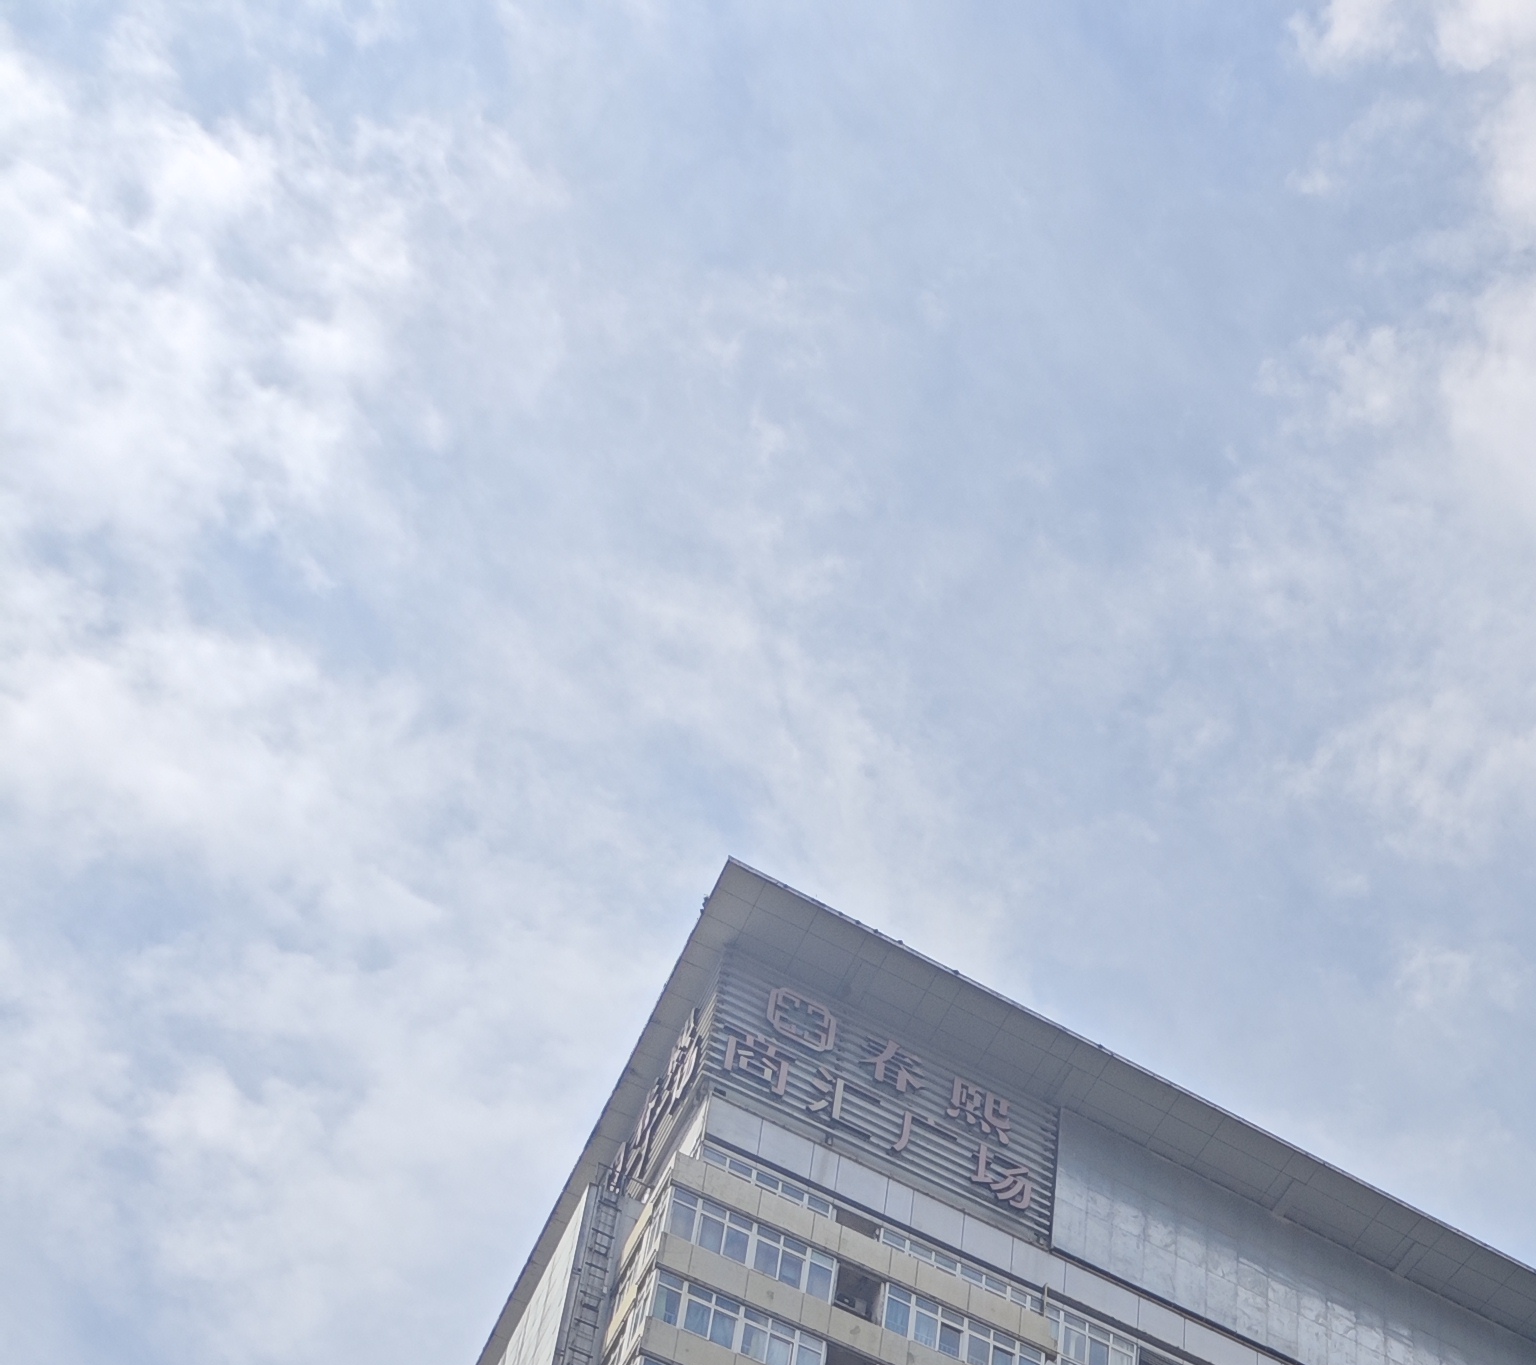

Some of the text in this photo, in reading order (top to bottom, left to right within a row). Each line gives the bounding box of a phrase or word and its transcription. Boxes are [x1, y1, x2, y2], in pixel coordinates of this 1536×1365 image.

[723, 1029, 1033, 1210] 商汇广场
[859, 1036, 1011, 1146] 春熙
